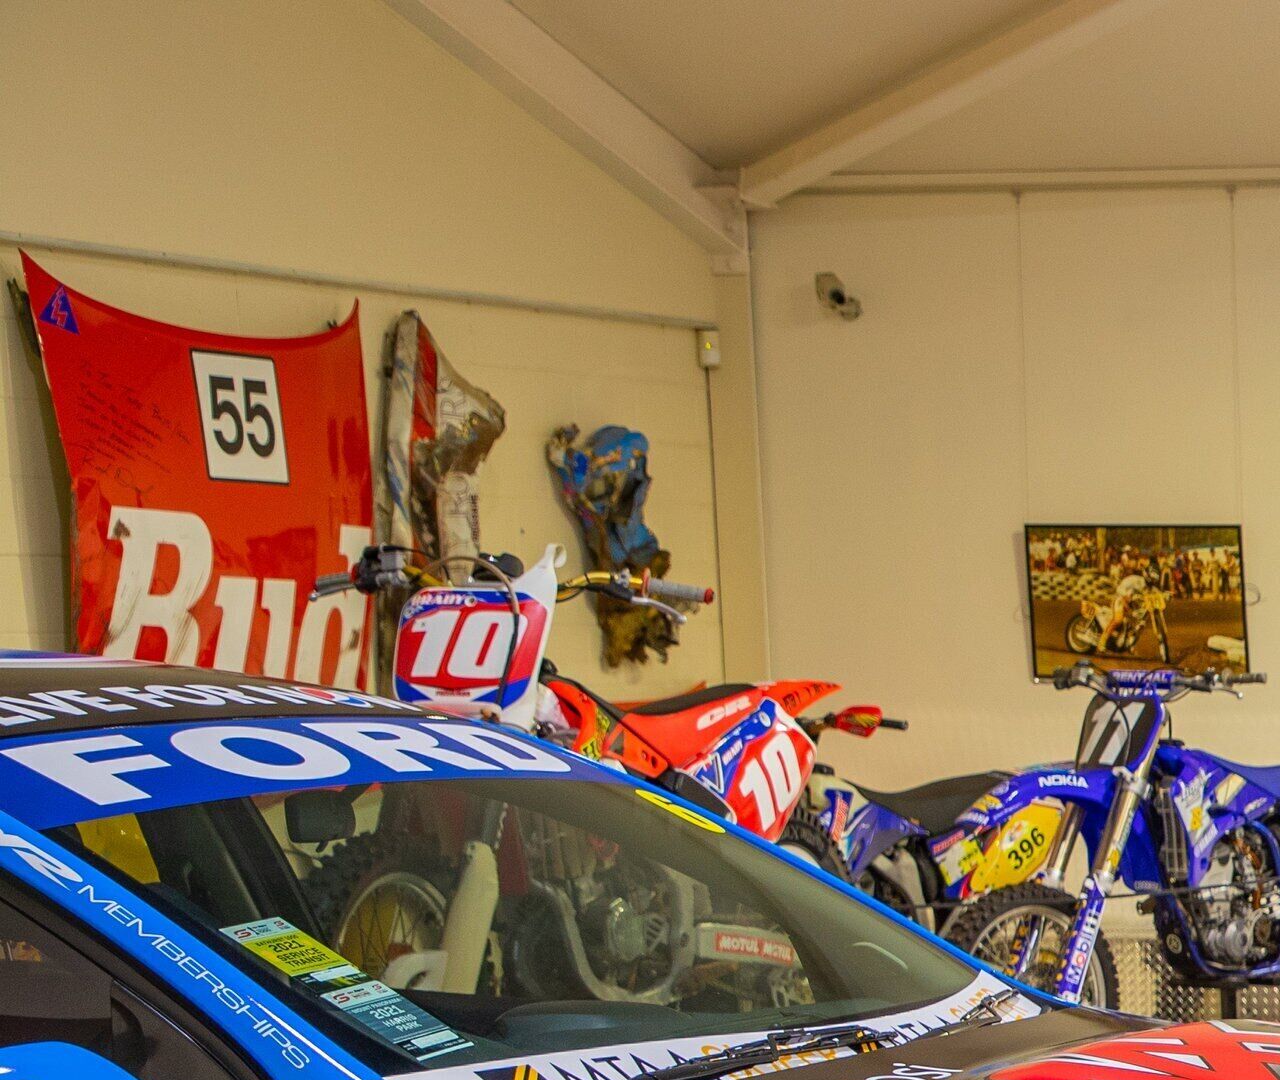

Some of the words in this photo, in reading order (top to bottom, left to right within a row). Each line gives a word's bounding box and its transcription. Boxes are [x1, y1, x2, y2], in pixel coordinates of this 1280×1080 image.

[209, 375, 275, 458] 55
[410, 610, 528, 679] 10
[0, 689, 88, 727] LIVE
[100, 684, 277, 714] FOR
[1078, 701, 1146, 766] 11
[2, 722, 572, 806] FORD
[739, 733, 802, 832] 10
[1037, 774, 1089, 789] NOKIA
[1008, 828, 1045, 870] 396
[268, 939, 306, 953] 2021
[276, 946, 321, 961] SERVICE
[284, 953, 330, 967] TRANSIT
[77, 884, 310, 1069] MEMBERSHIPS
[369, 1004, 406, 1019] 2021
[383, 1013, 418, 1028] HARRIS
[395, 1021, 422, 1033] PARK
